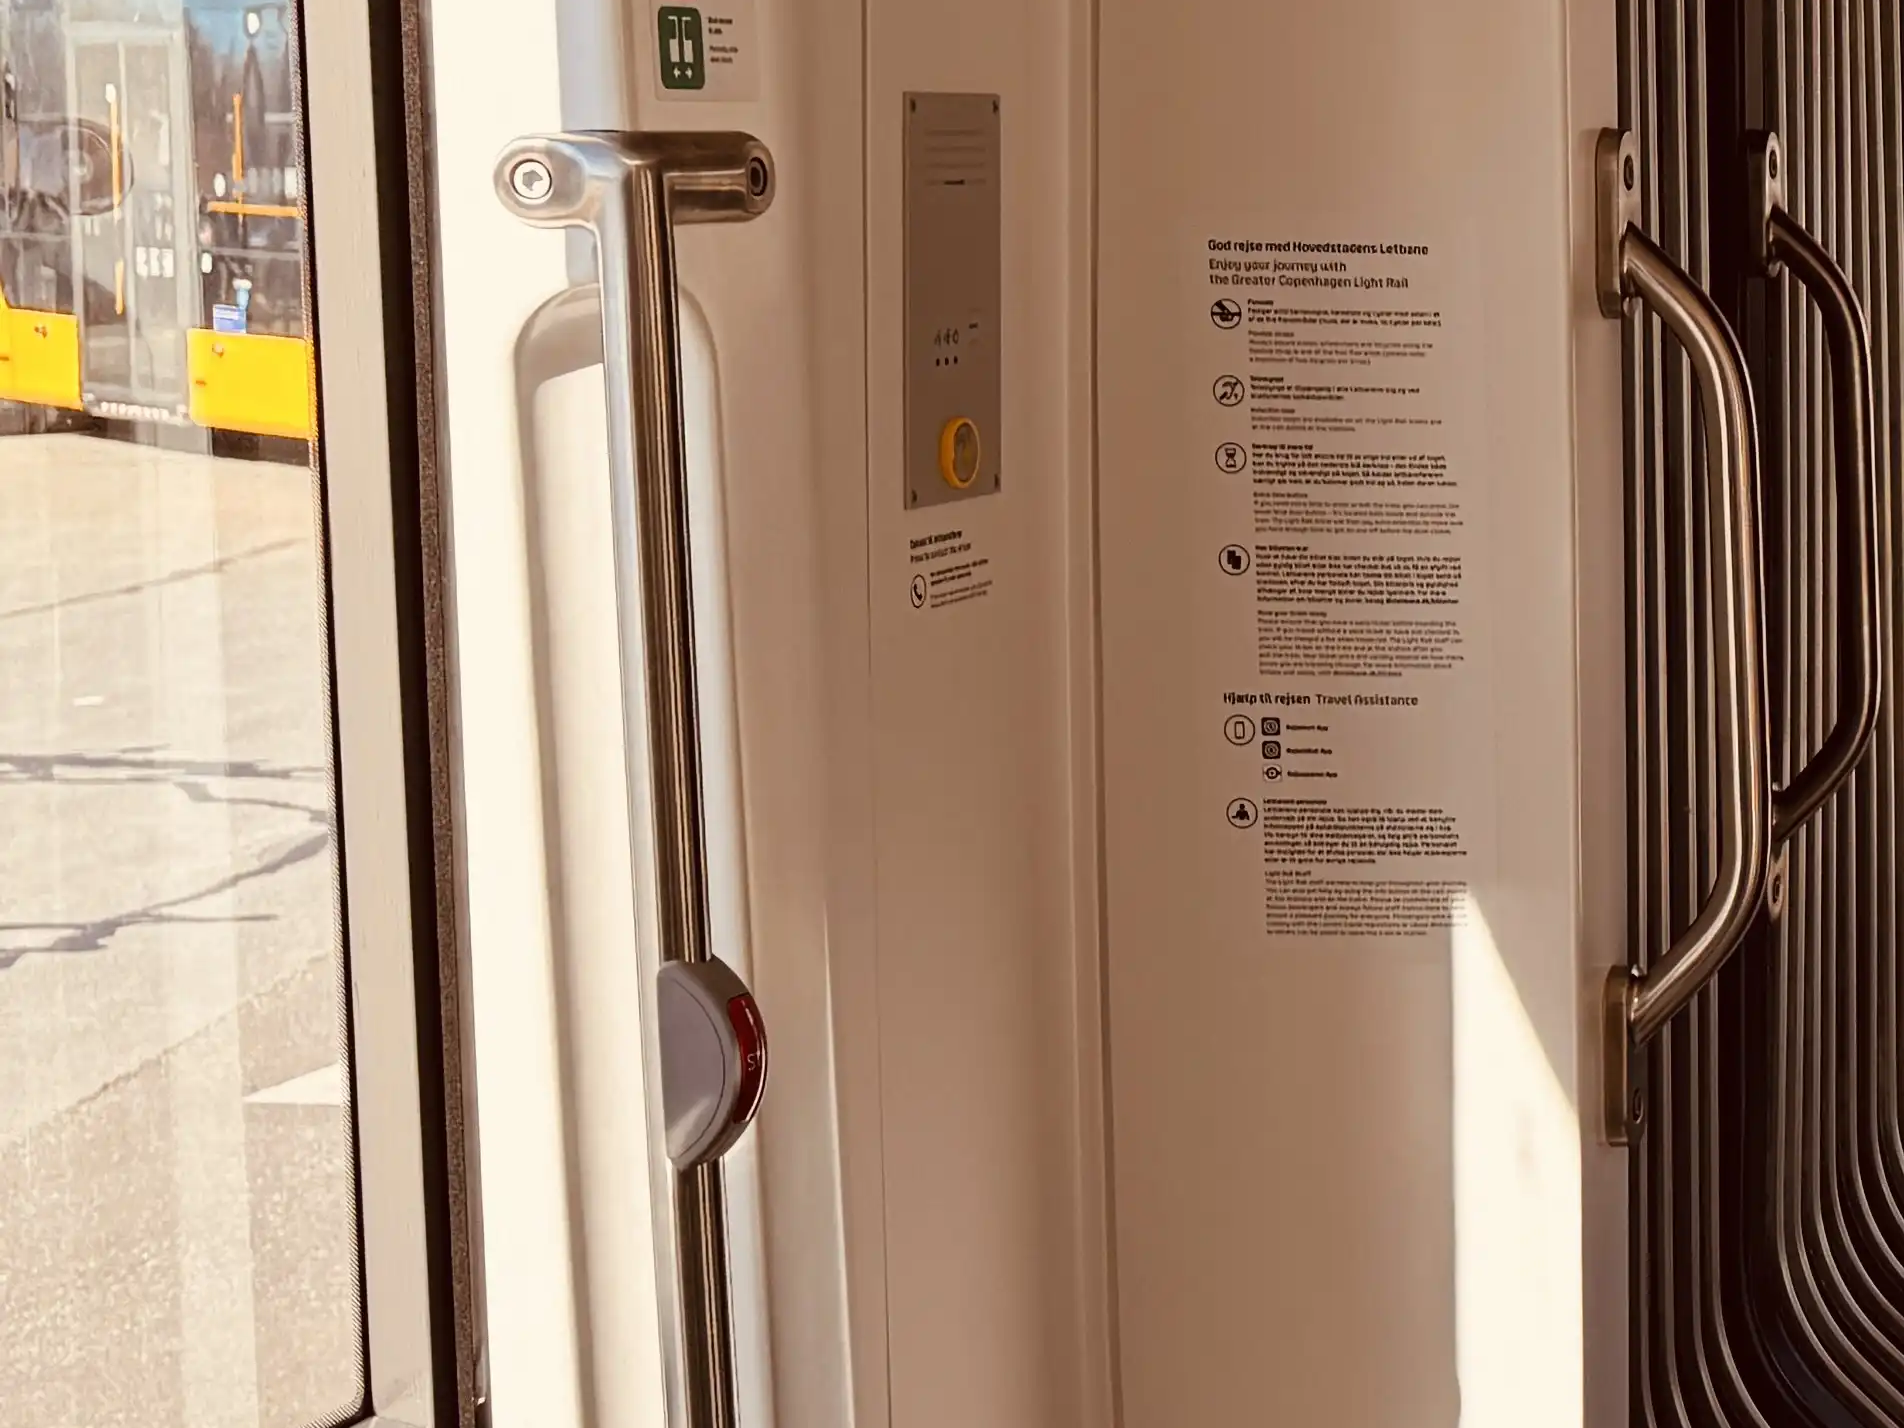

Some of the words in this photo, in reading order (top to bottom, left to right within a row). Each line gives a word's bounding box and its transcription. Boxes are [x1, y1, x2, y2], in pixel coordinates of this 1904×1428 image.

[1208, 239, 1232, 252] God
[1234, 241, 1263, 254] rejse
[1265, 241, 1291, 253] med
[1293, 241, 1378, 255] Hovedstadens
[1380, 243, 1429, 256] Letbane
[1209, 258, 1242, 272] Enjoy
[1244, 261, 1270, 273] your
[1273, 259, 1318, 274] journey
[1320, 260, 1347, 272] with
[1210, 274, 1229, 286] the
[1231, 274, 1276, 287] Greater
[1279, 275, 1352, 290] Copenhagen
[1354, 276, 1384, 290] Light
[1386, 276, 1409, 288] Rail
[1275, 693, 1311, 707] rejsen
[1315, 693, 1352, 706] Travel
[1354, 693, 1419, 707] Assistance
